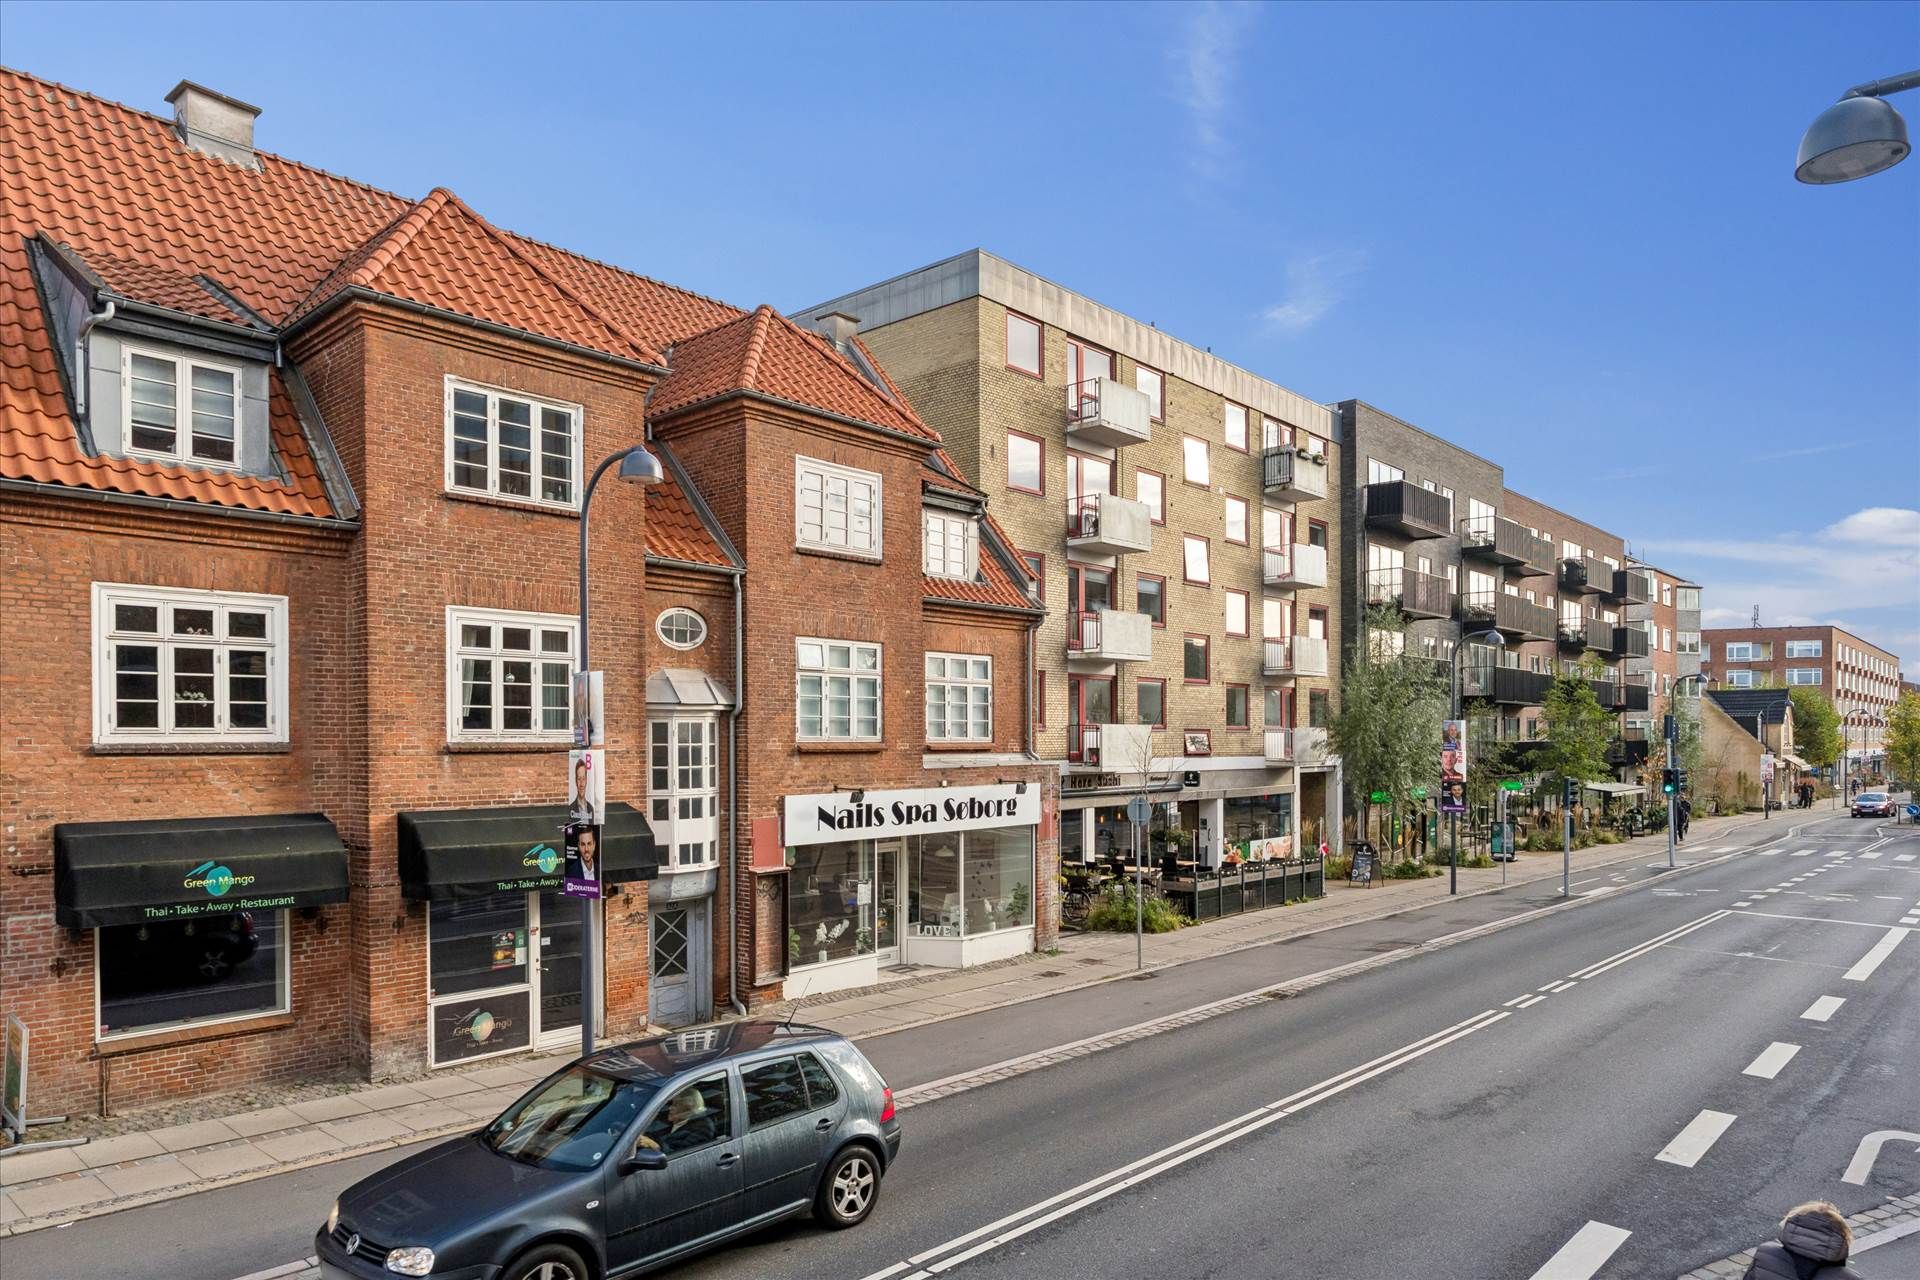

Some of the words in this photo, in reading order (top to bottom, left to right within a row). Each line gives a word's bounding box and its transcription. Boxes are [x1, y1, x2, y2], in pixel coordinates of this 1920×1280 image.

[817, 802, 885, 831] Nails
[891, 800, 937, 826] Spa
[943, 796, 1018, 822] Søborg
[522, 857, 546, 867] Green
[547, 856, 565, 865] Man
[184, 878, 216, 889] Green
[218, 874, 255, 886] Mango
[497, 882, 513, 890] Thai
[518, 880, 535, 889] Take
[540, 878, 559, 887] Away
[144, 907, 168, 918] Thai
[175, 905, 199, 915] Take
[206, 902, 234, 912] Away
[240, 896, 295, 909] Restaurant
[916, 924, 951, 937] LOVE
